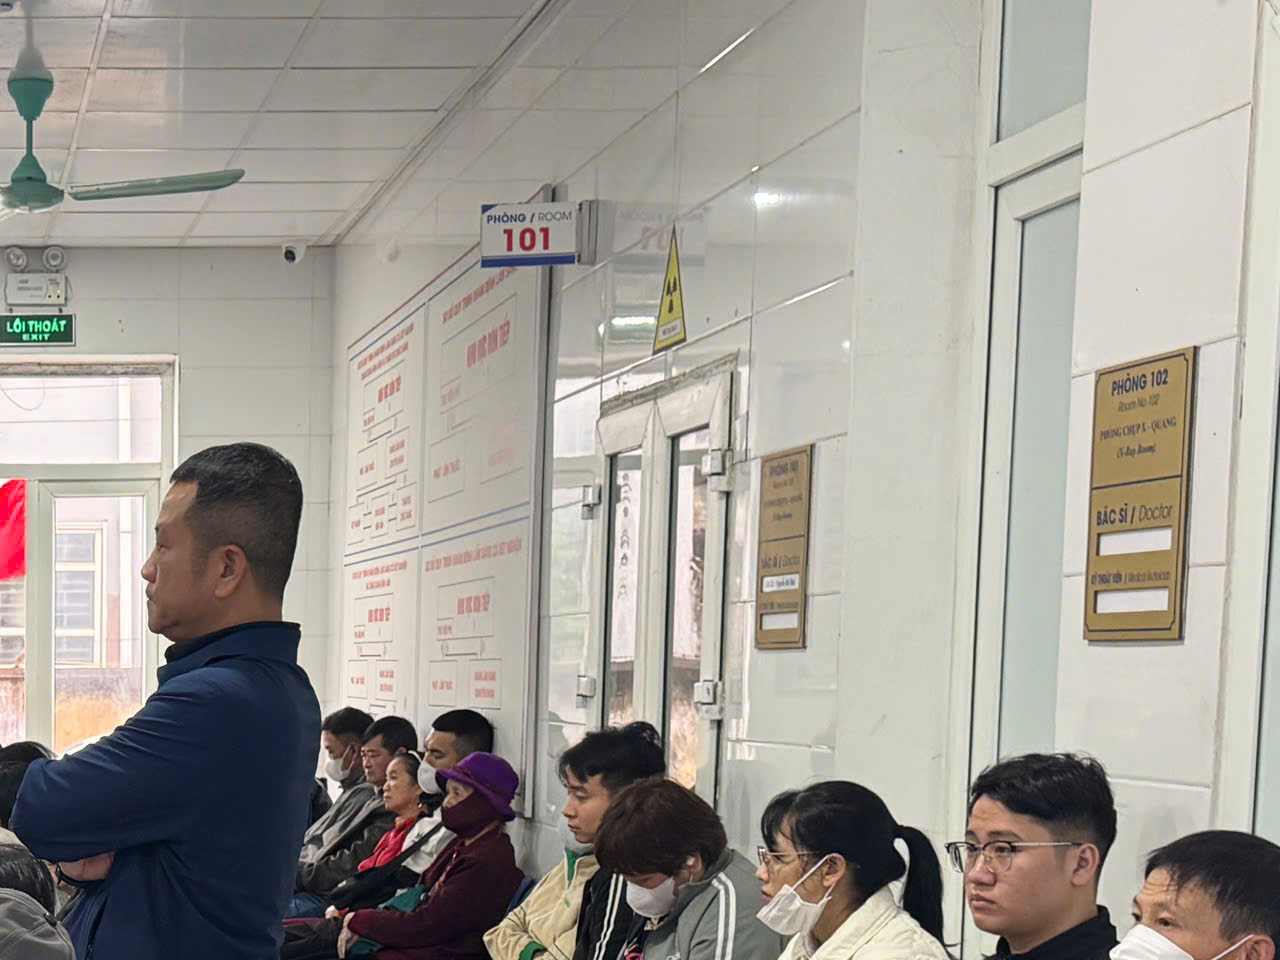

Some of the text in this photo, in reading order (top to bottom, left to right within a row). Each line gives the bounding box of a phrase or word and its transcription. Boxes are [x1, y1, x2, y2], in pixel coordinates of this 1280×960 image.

[487, 211, 526, 224] PHÒNG
[538, 211, 572, 221] ROOM
[503, 226, 550, 252] 101
[27, 317, 66, 332] THOÁT
[22, 333, 50, 341] EXIT
[1112, 368, 1169, 396] PHÒNG 102
[1096, 505, 1117, 526] BÁC
[1119, 503, 1128, 524] SĨ
[1138, 504, 1173, 522] Doctor
